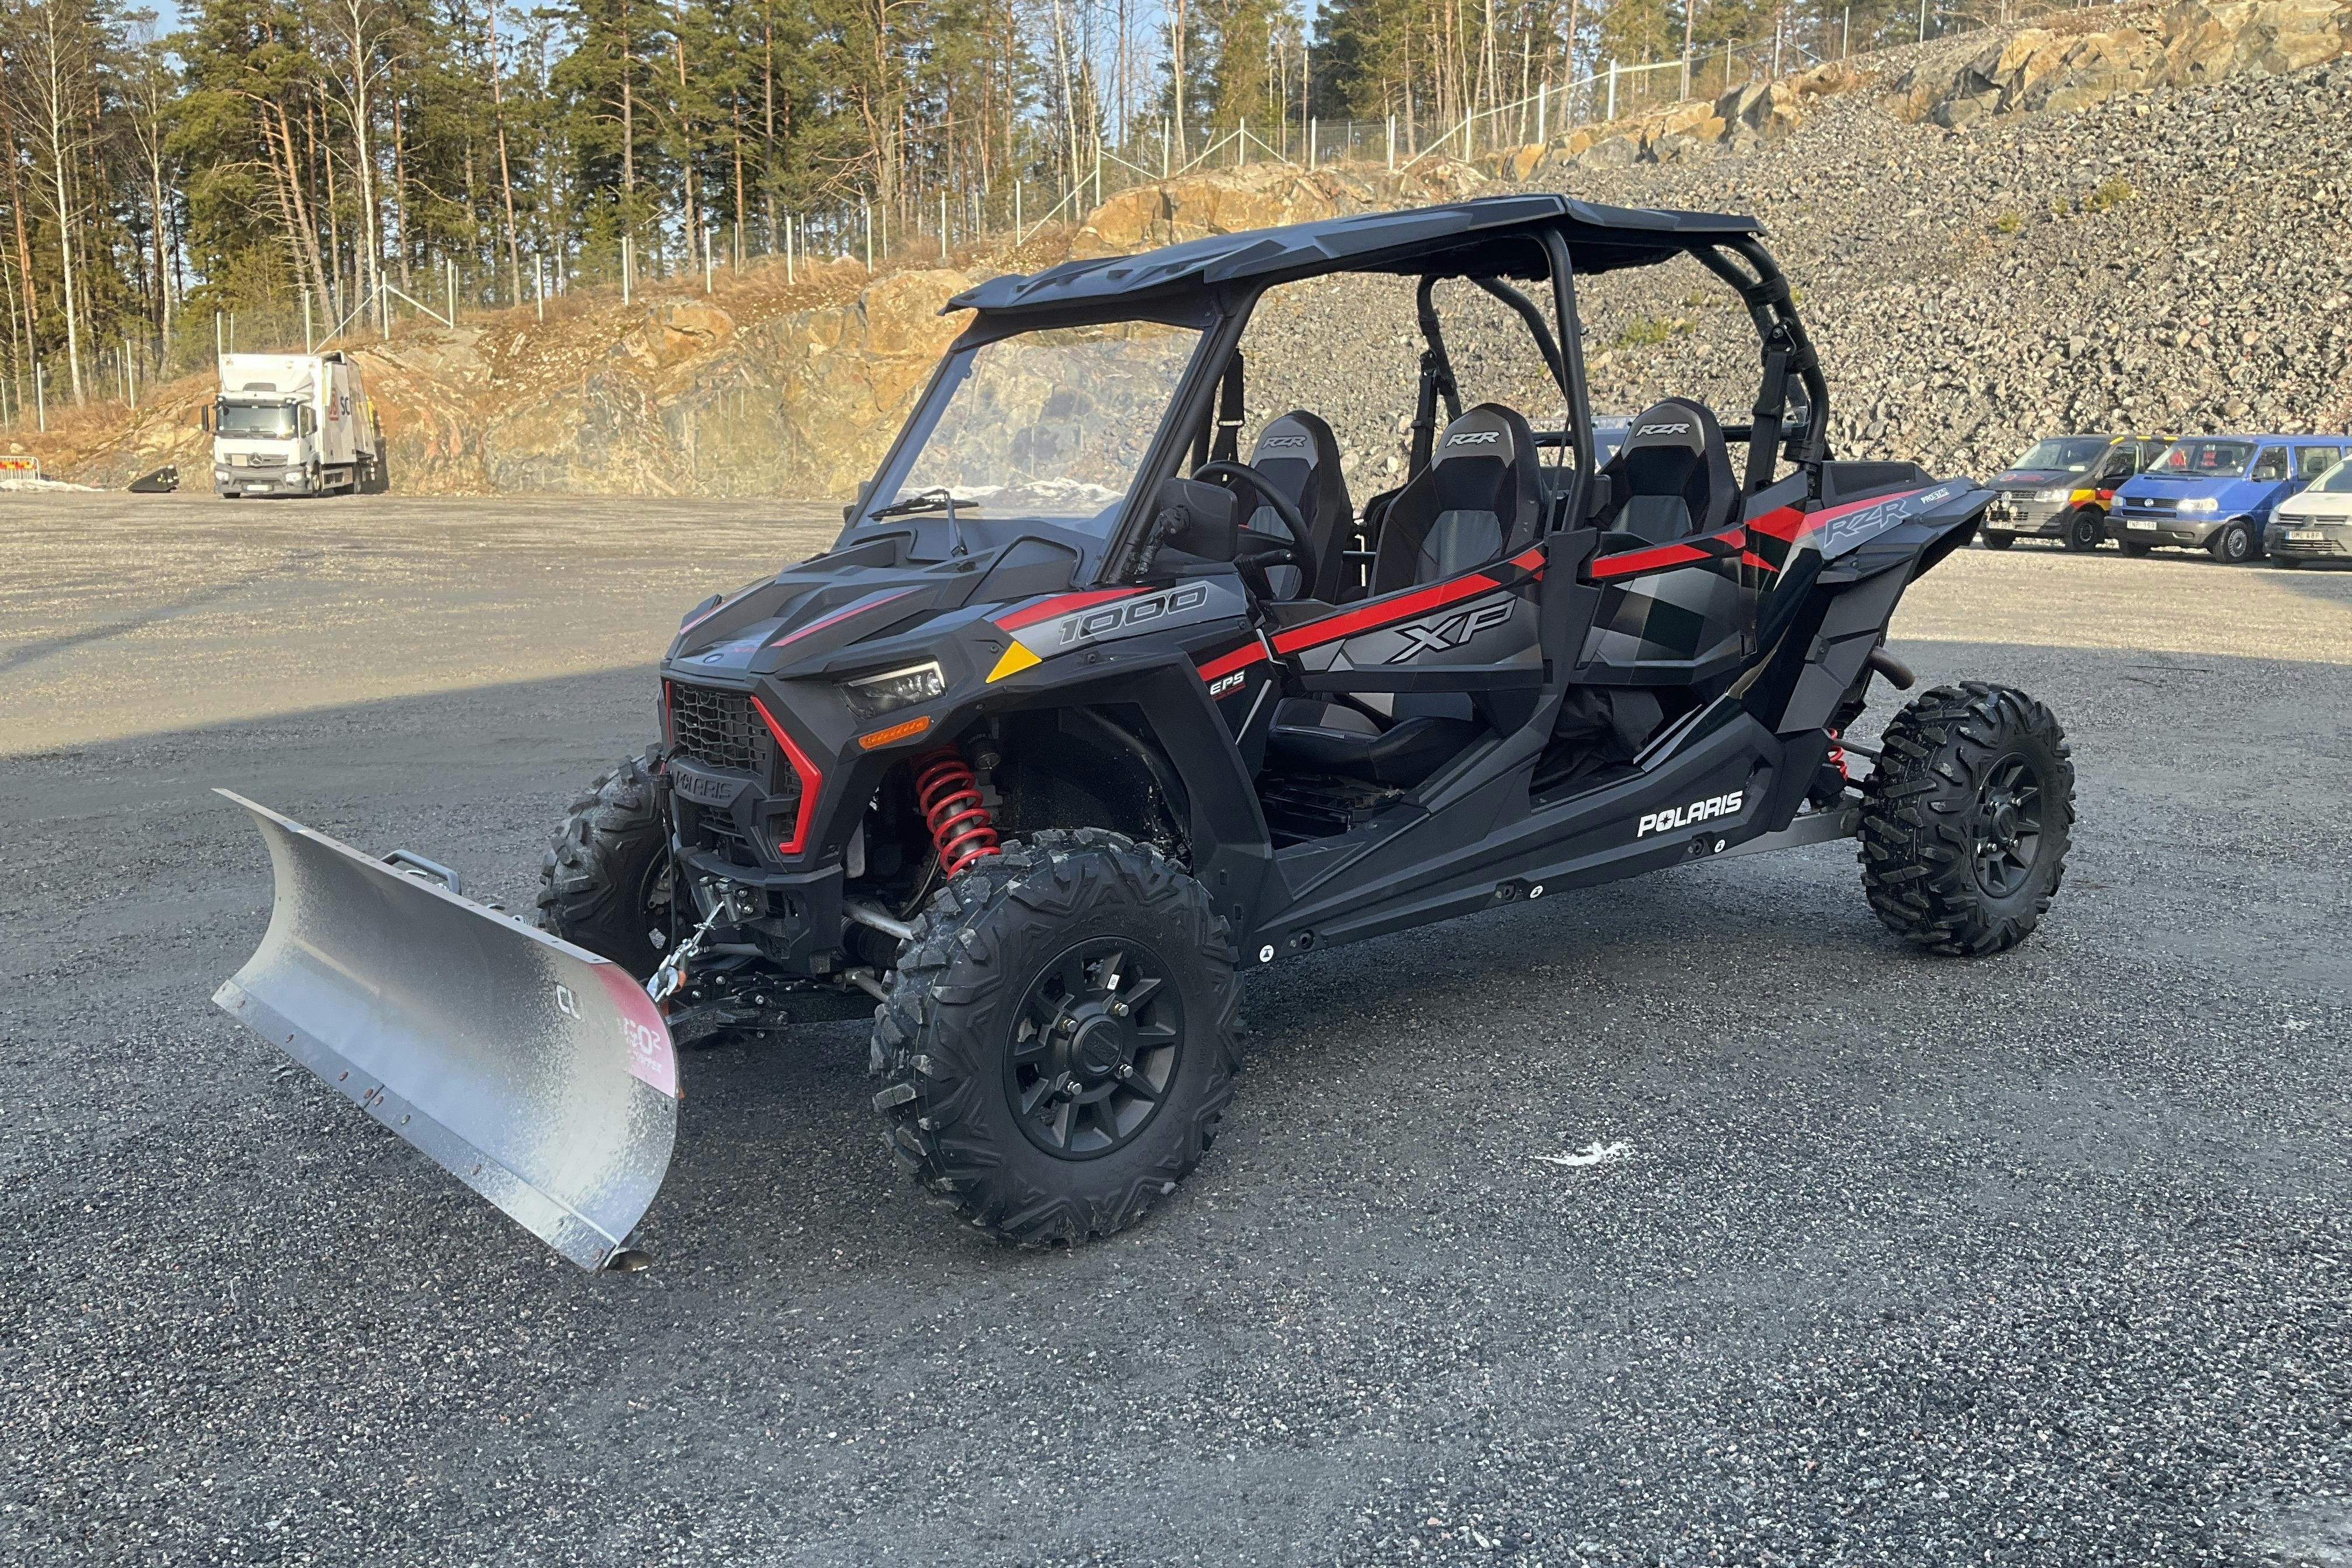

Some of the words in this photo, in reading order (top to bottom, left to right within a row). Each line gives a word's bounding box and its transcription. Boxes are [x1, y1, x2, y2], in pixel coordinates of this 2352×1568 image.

[1261, 435, 1307, 449] RZR
[1445, 431, 1500, 448] RZR
[1635, 423, 1690, 438] RZR
[1824, 498, 1912, 549] RZR
[1059, 583, 1209, 646] 1000
[1381, 596, 1517, 665] XP
[1210, 670, 1245, 695] EPS
[676, 770, 734, 800] POLARIS
[1637, 790, 1743, 838] POLARIS
